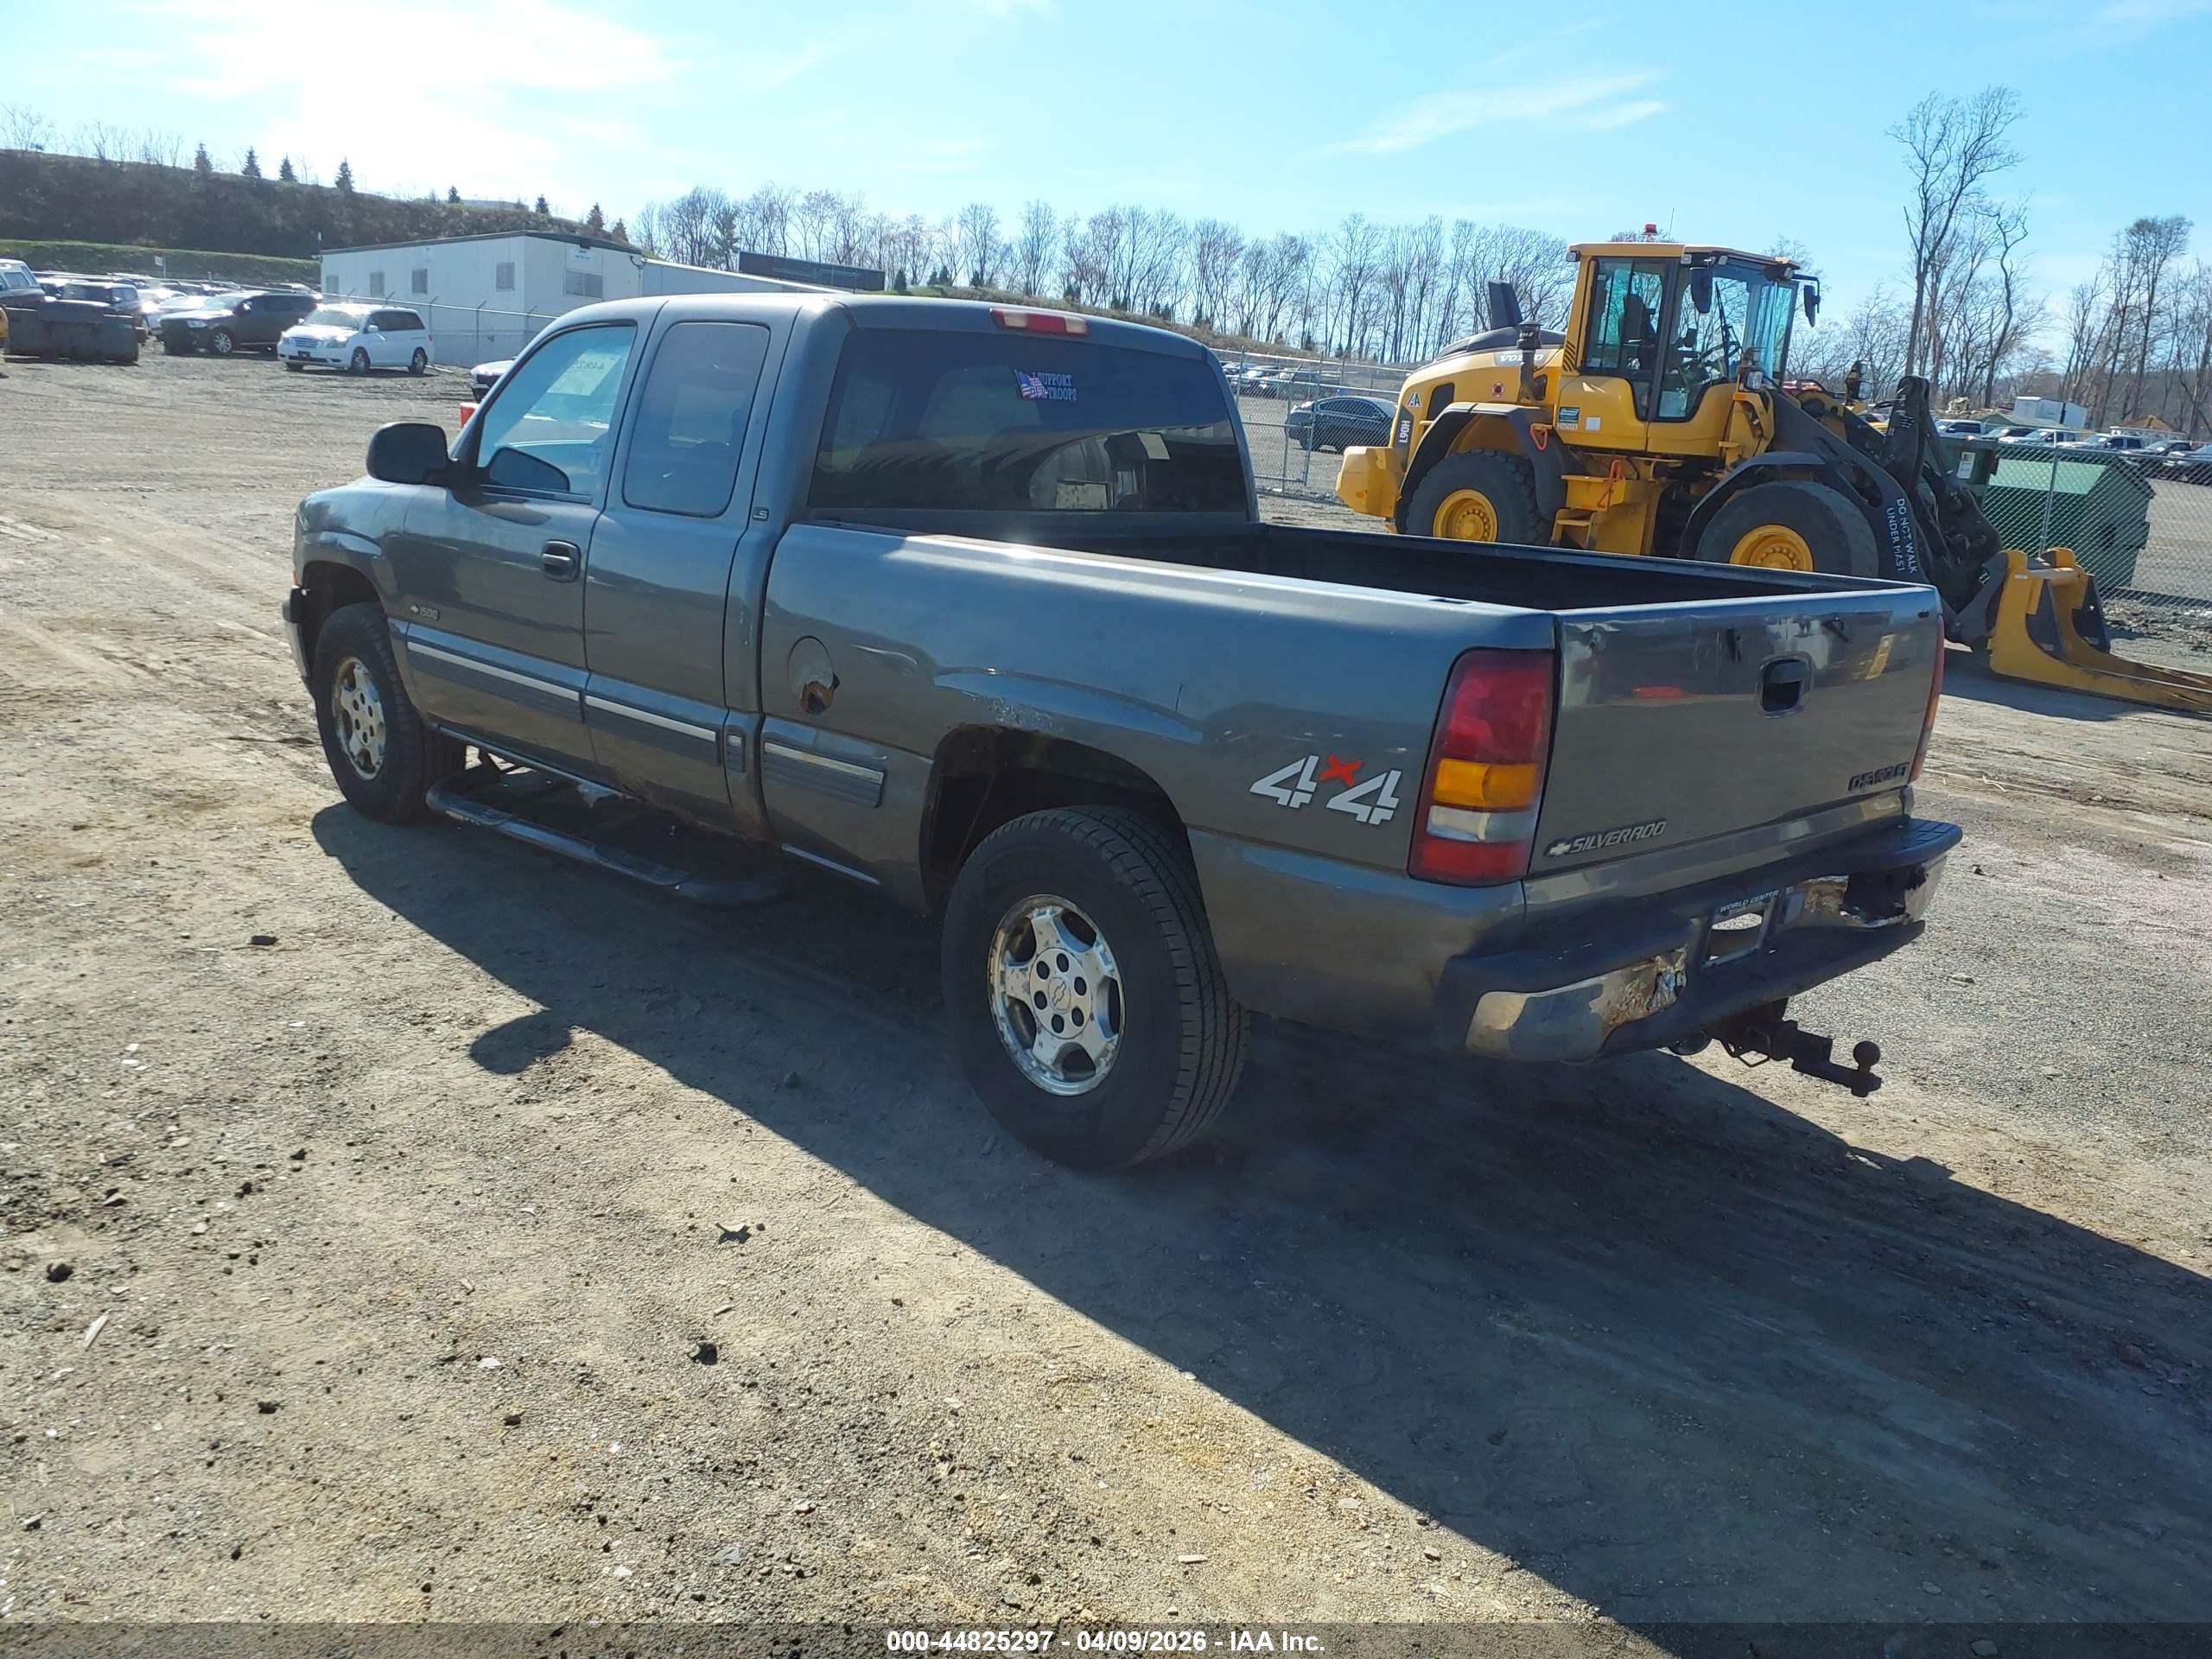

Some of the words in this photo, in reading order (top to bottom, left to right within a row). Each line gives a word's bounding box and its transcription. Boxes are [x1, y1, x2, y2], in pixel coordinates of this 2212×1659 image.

[1499, 353, 1544, 362] VOLO
[1398, 419, 1411, 443] L90H
[1897, 498, 1907, 515] DO
[1886, 506, 1900, 543] UNDER
[1900, 517, 1912, 540] NOT
[1905, 542, 1918, 574] WALK
[420, 607, 439, 620] 1500
[1569, 821, 1668, 854] SILVERADO
[1719, 899, 1749, 913] WORLD
[1749, 889, 1780, 906] CENTER
